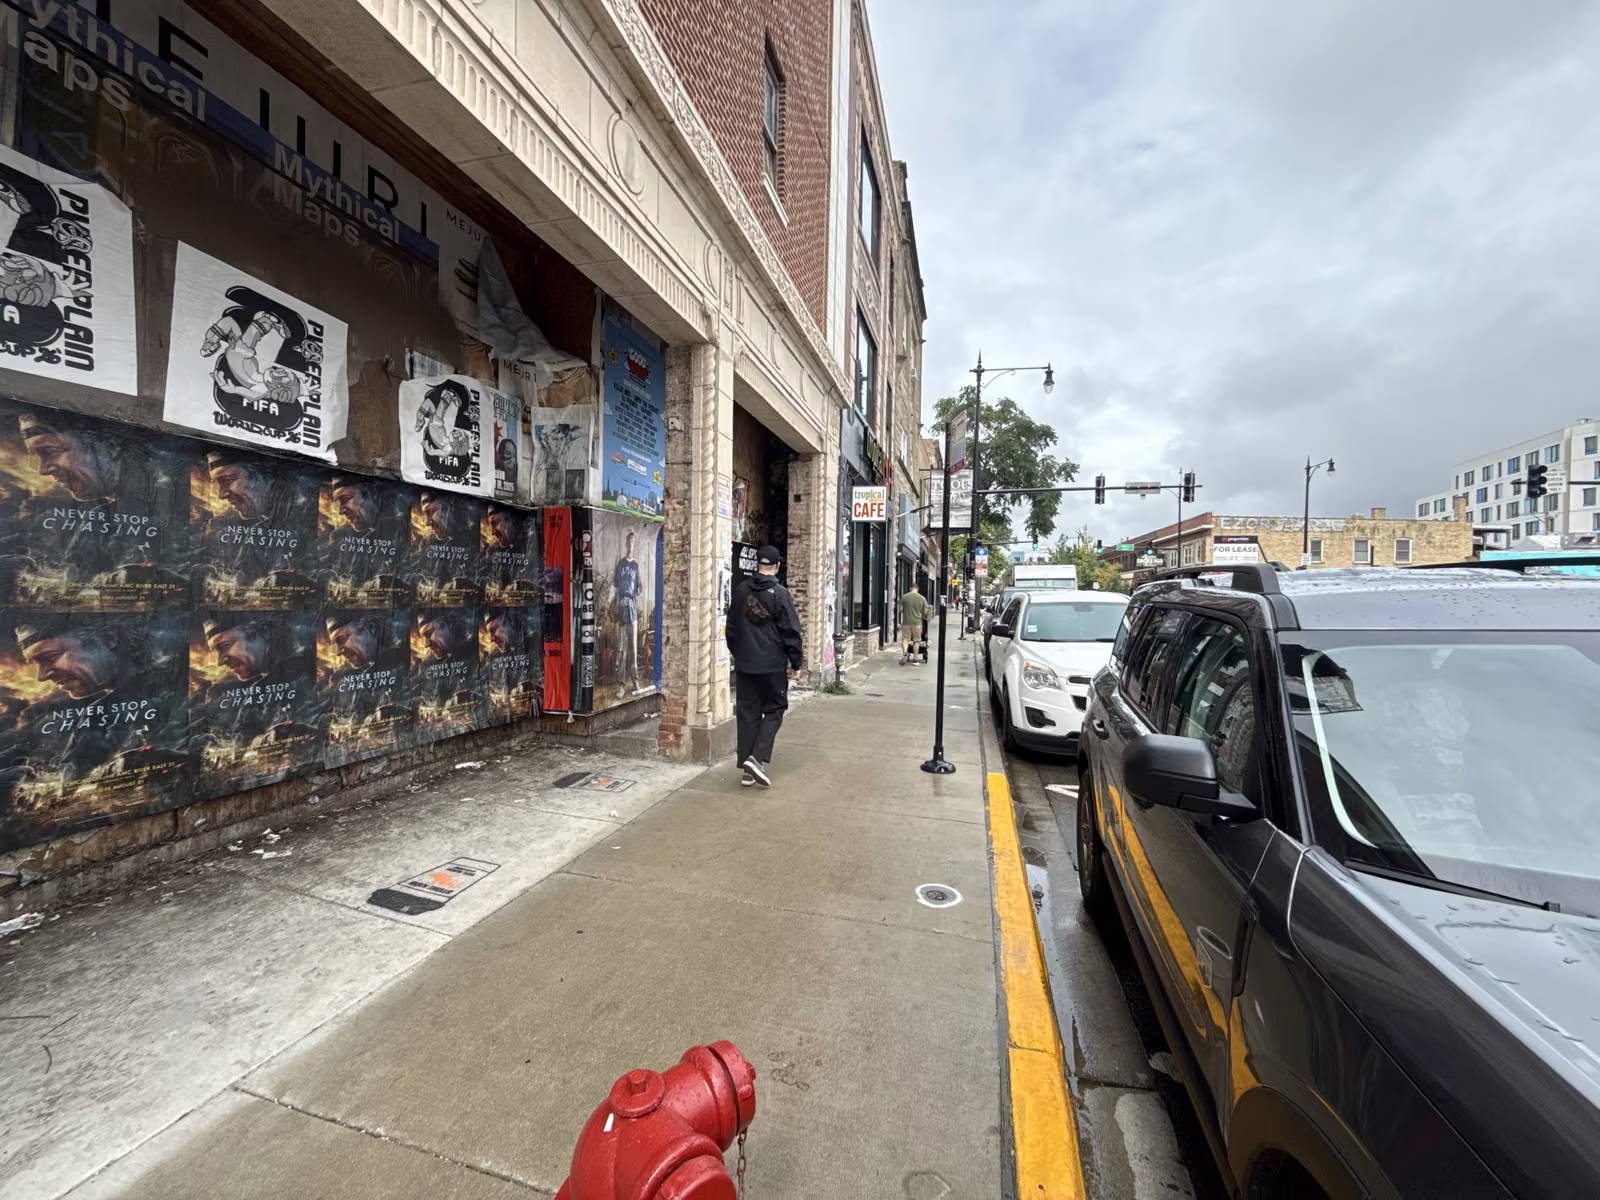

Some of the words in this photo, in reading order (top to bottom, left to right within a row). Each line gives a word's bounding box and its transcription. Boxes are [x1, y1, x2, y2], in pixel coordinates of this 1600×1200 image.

[28, 0, 206, 122] ythical
[274, 142, 400, 244] Mythical
[274, 172, 360, 246] Maps
[854, 489, 885, 501] tropical
[54, 507, 106, 522] NEVER
[113, 513, 150, 525] STOP
[853, 502, 885, 518] CAFE
[42, 518, 158, 537] CHASING
[227, 525, 264, 536] NEVER
[267, 528, 292, 538] STOP
[220, 533, 298, 548] CHASING
[344, 536, 372, 546] NEVER
[373, 538, 392, 547] STOP
[340, 543, 397, 556] CHASING
[426, 550, 469, 561] CHASING
[430, 544, 450, 552] NEVER
[451, 546, 466, 554] STOP
[426, 666, 468, 679] CHASING
[429, 662, 450, 672] NEVER
[450, 661, 465, 669] STOP
[339, 677, 396, 693] CHASING
[343, 672, 372, 684] NEVER
[372, 670, 391, 680] STOP
[226, 686, 263, 698] NEVER
[265, 682, 290, 694] STOP
[219, 689, 297, 709] CHASING
[52, 705, 105, 720] NEVER
[111, 700, 148, 713] STOP
[41, 708, 157, 735] CHASING
